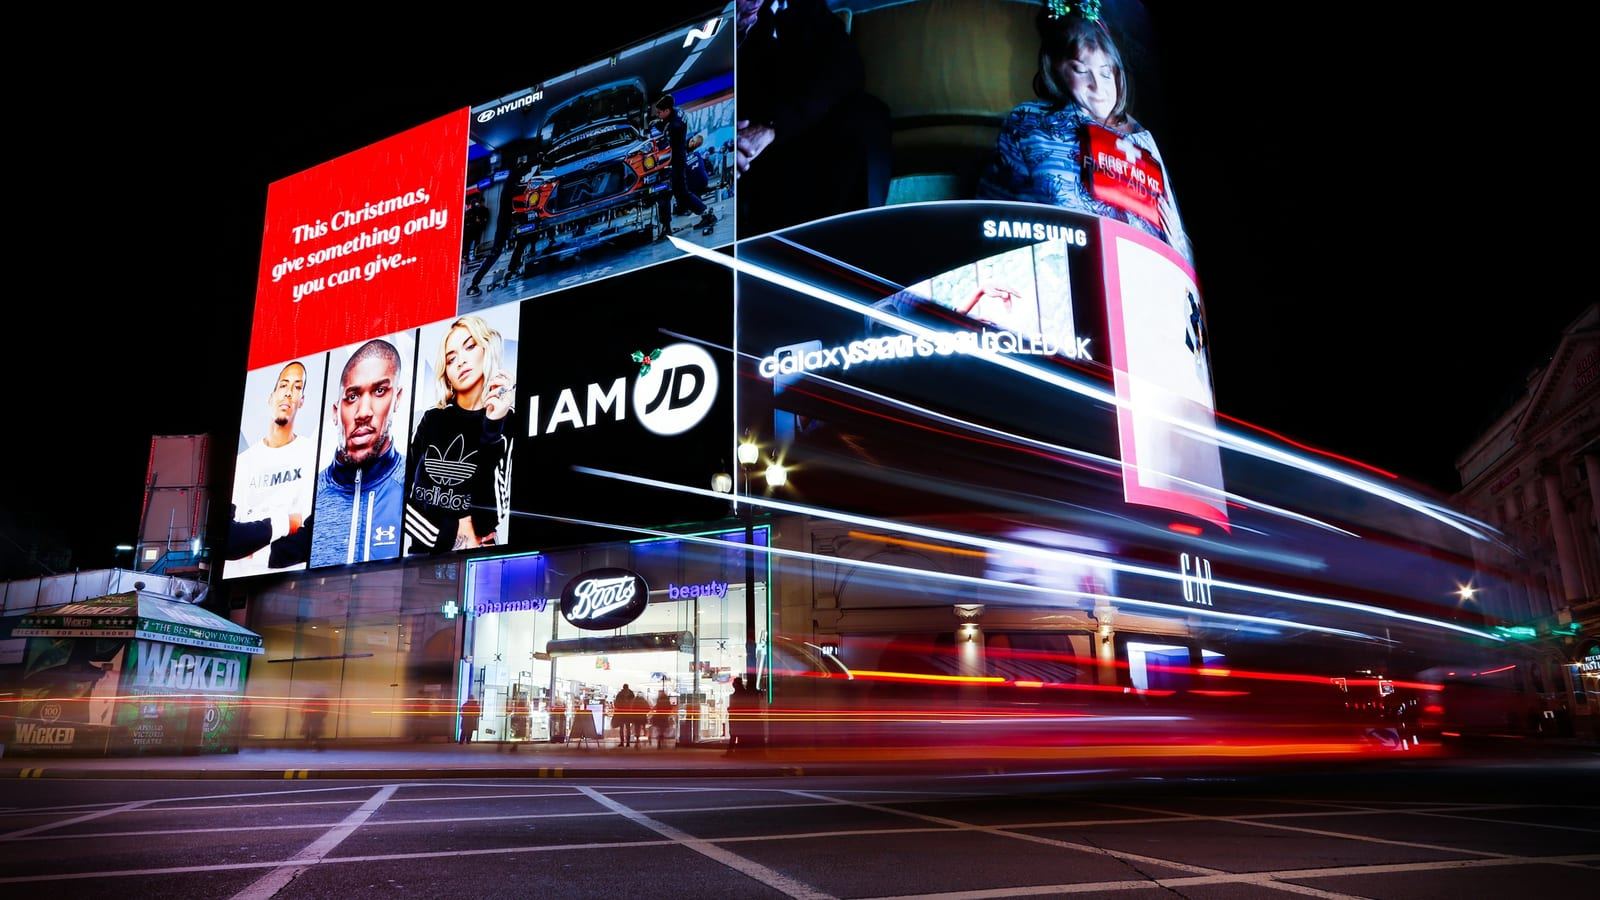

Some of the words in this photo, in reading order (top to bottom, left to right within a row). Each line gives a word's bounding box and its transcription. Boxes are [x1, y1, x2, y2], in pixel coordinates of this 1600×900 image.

[497, 90, 543, 116] HYUNDAI
[1098, 152, 1129, 176] FIRST
[1130, 166, 1146, 184] AID
[292, 219, 328, 245] This
[331, 187, 430, 231] Christmas,
[983, 220, 1087, 246] SAMSUNG
[271, 256, 304, 282] give
[306, 224, 401, 267] something
[404, 208, 448, 236] only
[292, 278, 324, 302] you
[327, 265, 361, 287] can
[364, 253, 417, 281] give...
[758, 343, 851, 380] Galaxy
[528, 395, 539, 437] I
[546, 376, 627, 434] AM
[645, 363, 706, 415] JD
[415, 485, 472, 511] adidas
[669, 580, 728, 599] beauty
[1180, 552, 1213, 606] GAP
[477, 598, 548, 617] pharmacy
[567, 576, 636, 620] Boots
